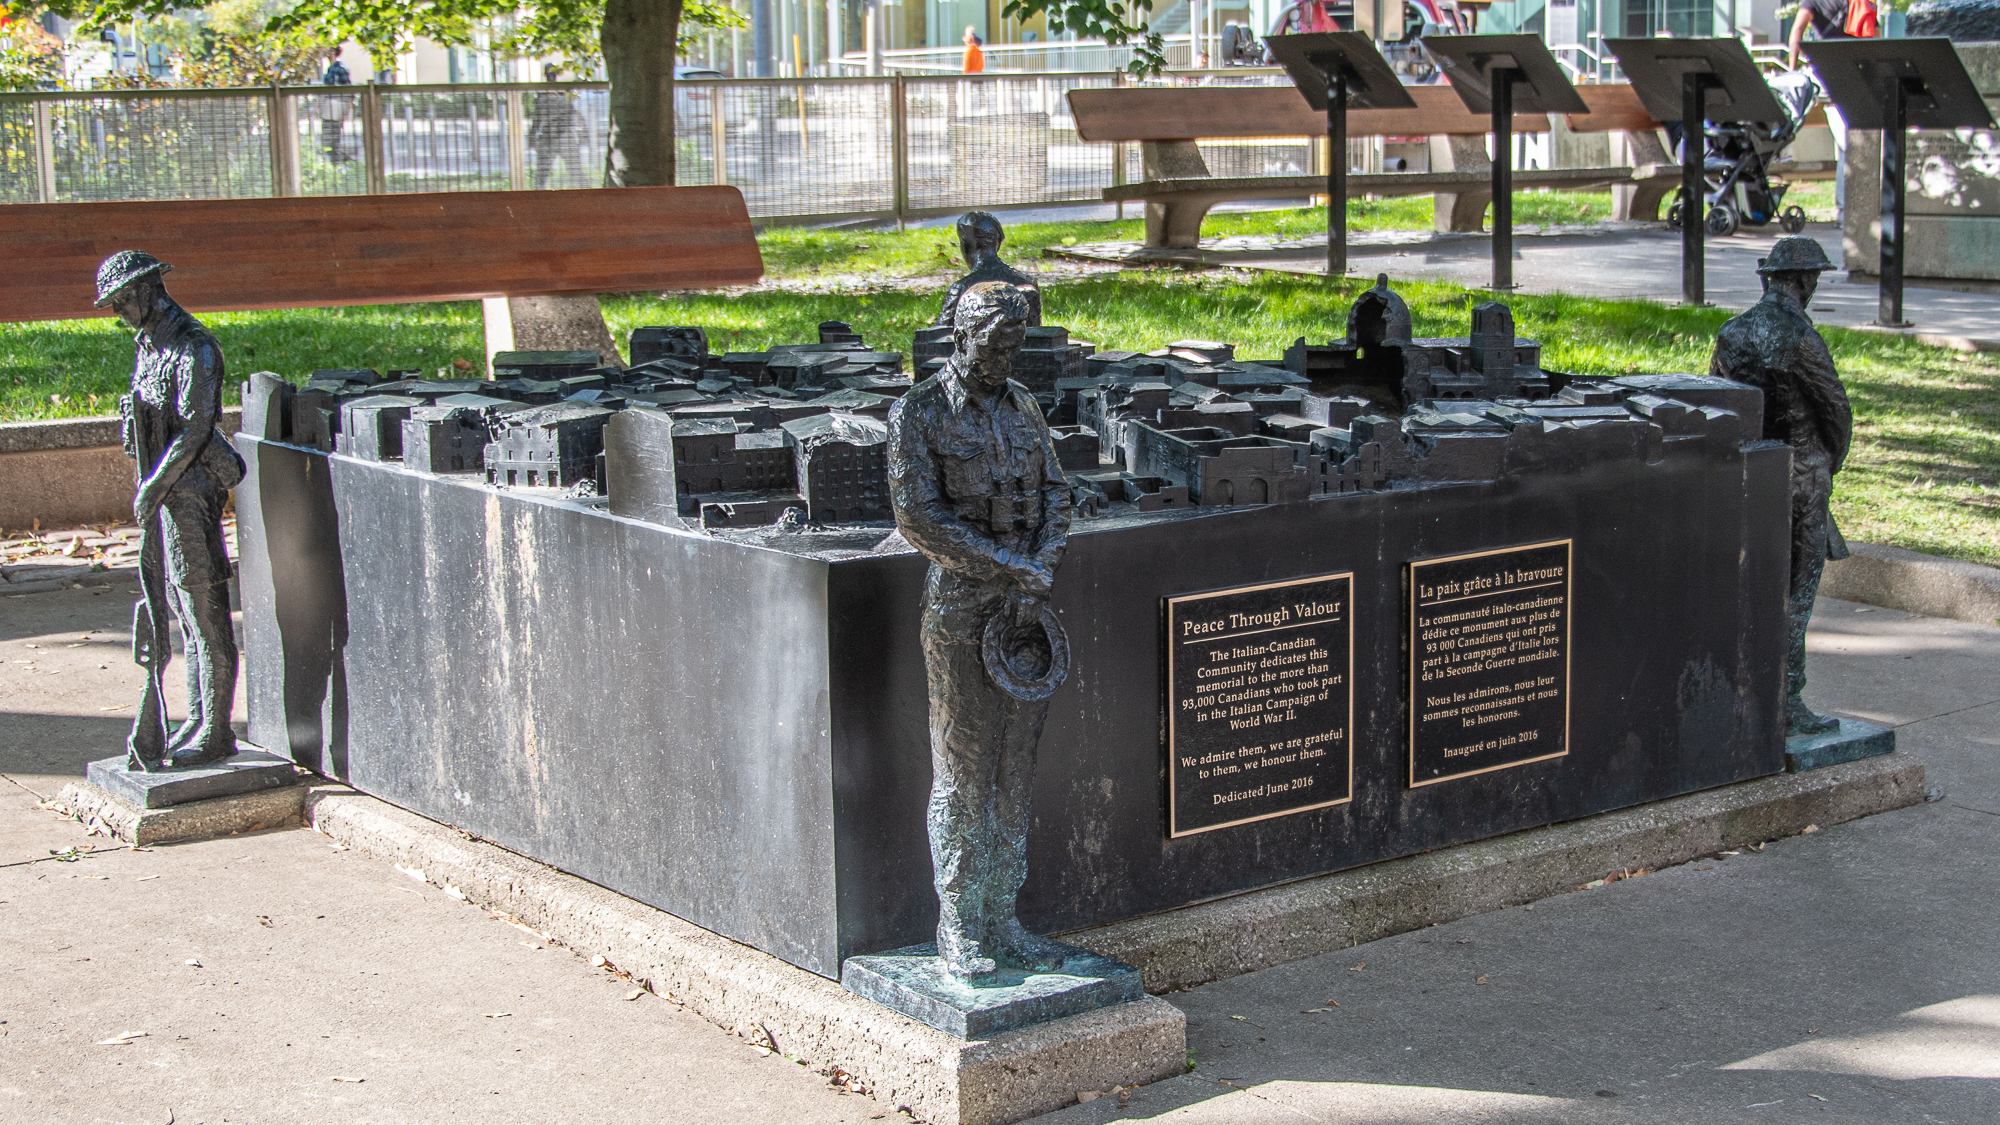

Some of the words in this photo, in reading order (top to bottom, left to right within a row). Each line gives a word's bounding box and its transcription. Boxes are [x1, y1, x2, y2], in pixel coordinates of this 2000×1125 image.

[1420, 585, 1433, 598] La
[1437, 581, 1460, 600] paix
[1463, 577, 1492, 595] grâce
[1495, 574, 1500, 586] à
[1504, 571, 1514, 584] la
[1517, 566, 1563, 582] bravoure
[1183, 620, 1224, 636] Peace
[1230, 606, 1289, 628] Through
[1295, 602, 1340, 618] Valour
[1419, 617, 1430, 627] La
[1433, 607, 1489, 626] communauté
[1492, 596, 1563, 615] italo-canadienne
[1422, 628, 1446, 641] dédie
[1450, 627, 1459, 636] ce
[1462, 617, 1508, 633] monument
[1511, 617, 1526, 625] aux
[1529, 611, 1547, 625] plus
[1550, 609, 1560, 618] de
[1210, 651, 1229, 662] The
[1232, 638, 1316, 658] Italian-Canadian
[1422, 656, 1441, 670] part
[1445, 654, 1449, 663] à
[1452, 653, 1460, 662] la
[1463, 645, 1506, 661] campagne
[1543, 636, 1559, 646] lors
[1426, 644, 1437, 653] 93
[1440, 640, 1455, 650] 000
[1457, 631, 1503, 648] Canadiens
[1505, 629, 1519, 641] qui
[1522, 628, 1536, 636] ont
[1539, 623, 1556, 636] pris
[1196, 676, 1245, 693] memorial
[1248, 676, 1257, 684] to
[1261, 671, 1276, 682] the
[1280, 668, 1304, 679] more
[1307, 664, 1329, 675] than
[1197, 661, 1256, 678] Community
[1260, 652, 1306, 668] dedicates
[1309, 649, 1328, 660] this
[1421, 671, 1432, 681] de
[1436, 669, 1443, 679] la
[1447, 662, 1483, 677] Seconde
[1485, 657, 1515, 669] Guerre
[1518, 649, 1560, 664] mondiale.
[1182, 696, 1215, 711] 93,000
[1218, 685, 1270, 704] Canadians
[1273, 681, 1294, 693] who
[1297, 677, 1319, 691] took
[1322, 674, 1342, 689] part
[1197, 711, 1207, 722] in
[1211, 709, 1227, 720] the
[1230, 700, 1263, 717] Italian
[1266, 693, 1316, 710] Campaign
[1318, 690, 1329, 699] of
[1423, 707, 1458, 722] sommes
[1461, 694, 1525, 714] reconnaissants
[1527, 692, 1535, 701] et
[1538, 689, 1557, 699] nous
[1427, 695, 1450, 707] Nous
[1453, 693, 1466, 702] les
[1468, 685, 1512, 700] admirons,
[1514, 681, 1534, 691] nous
[1538, 676, 1555, 686] leur
[1230, 716, 1260, 730] World
[1263, 713, 1282, 724] War
[1286, 710, 1297, 720] II.
[1463, 718, 1475, 728] les
[1478, 709, 1520, 724] honorons.
[1181, 757, 1196, 768] We
[1200, 750, 1235, 765] admire
[1238, 746, 1266, 758] them,
[1270, 741, 1283, 751] we
[1286, 739, 1301, 748] are
[1305, 728, 1343, 747] grateful
[1444, 741, 1483, 758] Inauguré
[1486, 740, 1497, 749] en
[1499, 735, 1516, 749] juin
[1519, 730, 1538, 742] 2016
[1199, 770, 1209, 779] to
[1213, 763, 1241, 777] them,
[1244, 761, 1258, 770] we
[1261, 752, 1296, 767] honour
[1300, 749, 1326, 760] them.
[1213, 784, 1263, 805] Dedicated
[1266, 782, 1288, 796] June
[1292, 776, 1313, 789] 2016
